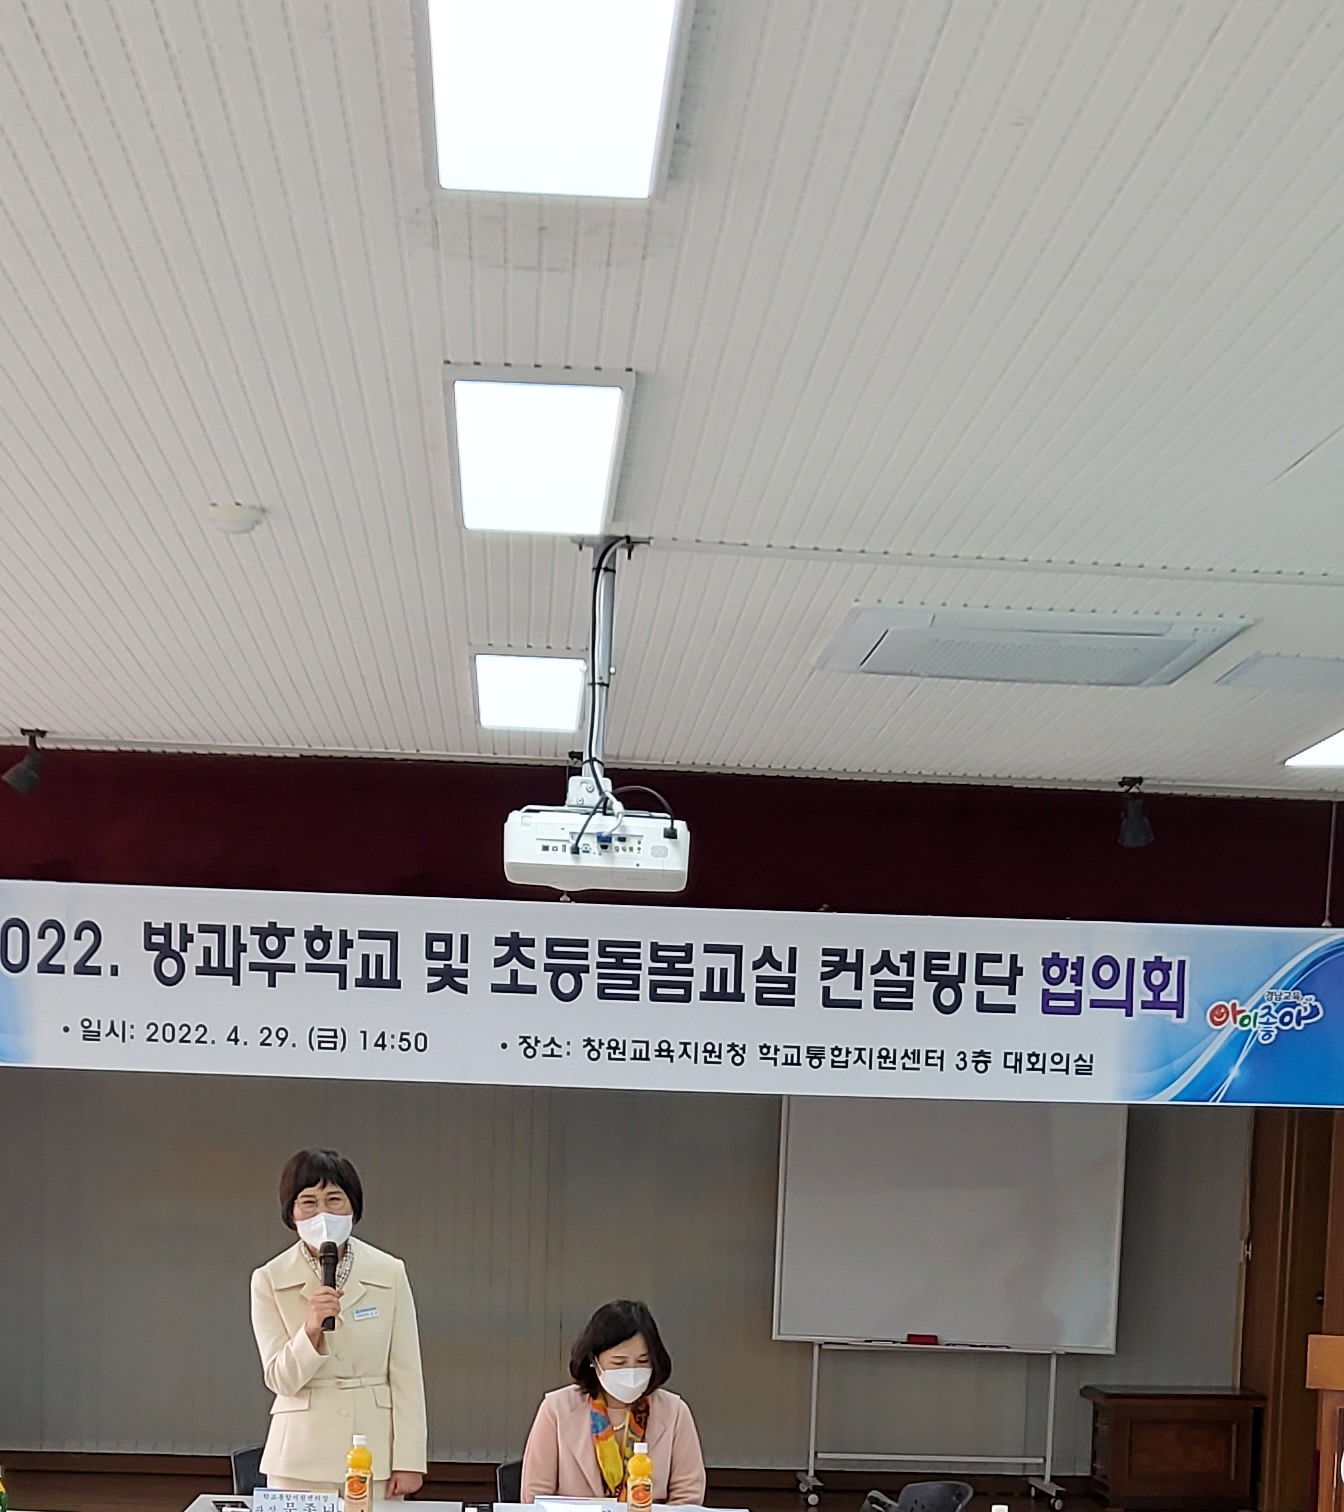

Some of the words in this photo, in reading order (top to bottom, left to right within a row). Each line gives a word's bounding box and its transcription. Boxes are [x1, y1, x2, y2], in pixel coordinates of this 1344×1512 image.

[143, 921, 402, 991] 방과후학교
[424, 932, 469, 995] 및
[490, 931, 798, 1008] 초등돌봄교실
[819, 947, 1024, 1016] 컨설팅단
[1041, 950, 1186, 1019] 협의회
[80, 1017, 135, 1044] 일시:
[145, 1021, 216, 1046] 2022.
[226, 1025, 248, 1047] 4.
[259, 1026, 296, 1048] 29.
[308, 1025, 347, 1053] (금)
[359, 1030, 428, 1053] 14:50
[1209, 1002, 1321, 1042] 아이좋아
[518, 1035, 571, 1060] 장소:
[582, 1036, 747, 1067] 창원교육지원청
[758, 1042, 945, 1073] 학교통합지원센터
[955, 1049, 992, 1074] 3층
[1003, 1050, 1094, 1076] 대회의실
